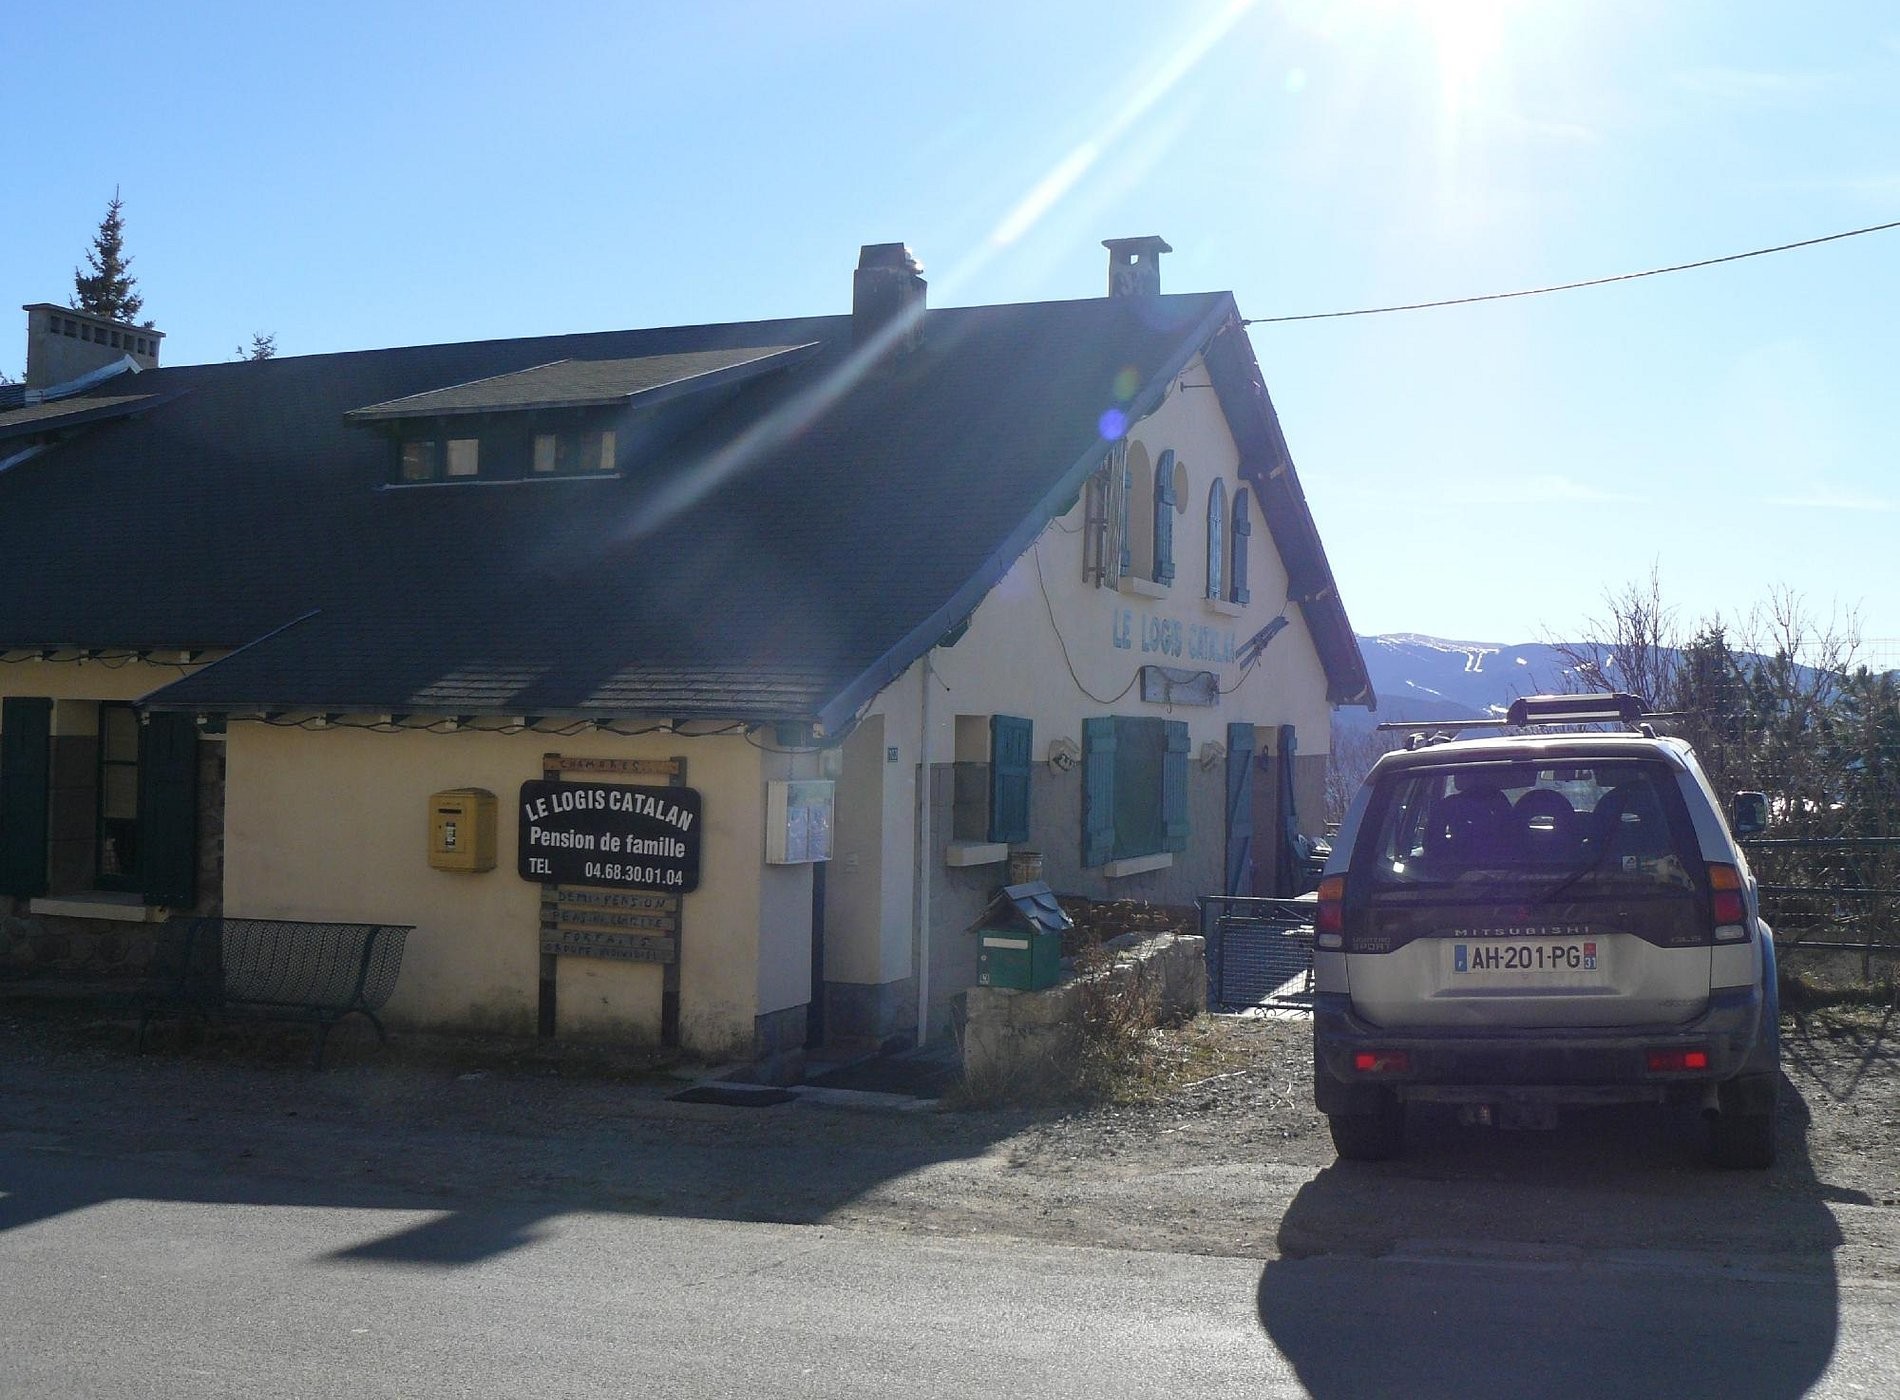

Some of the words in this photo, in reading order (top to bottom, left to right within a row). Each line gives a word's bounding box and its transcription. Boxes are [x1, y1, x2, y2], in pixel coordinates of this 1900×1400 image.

[1113, 608, 1131, 649] LE
[526, 797, 549, 822] LE
[552, 790, 605, 813] LOGIS
[609, 791, 693, 832] CATALAN
[530, 826, 595, 850] Pension
[600, 832, 621, 852] de
[626, 834, 686, 858] famille
[529, 858, 552, 874] TEL
[585, 861, 683, 886] 04.68.30.01.04
[1455, 926, 1589, 936] MITSUBISHI
[1472, 945, 1581, 969] AH-201-PG
[1585, 957, 1597, 968] 31
